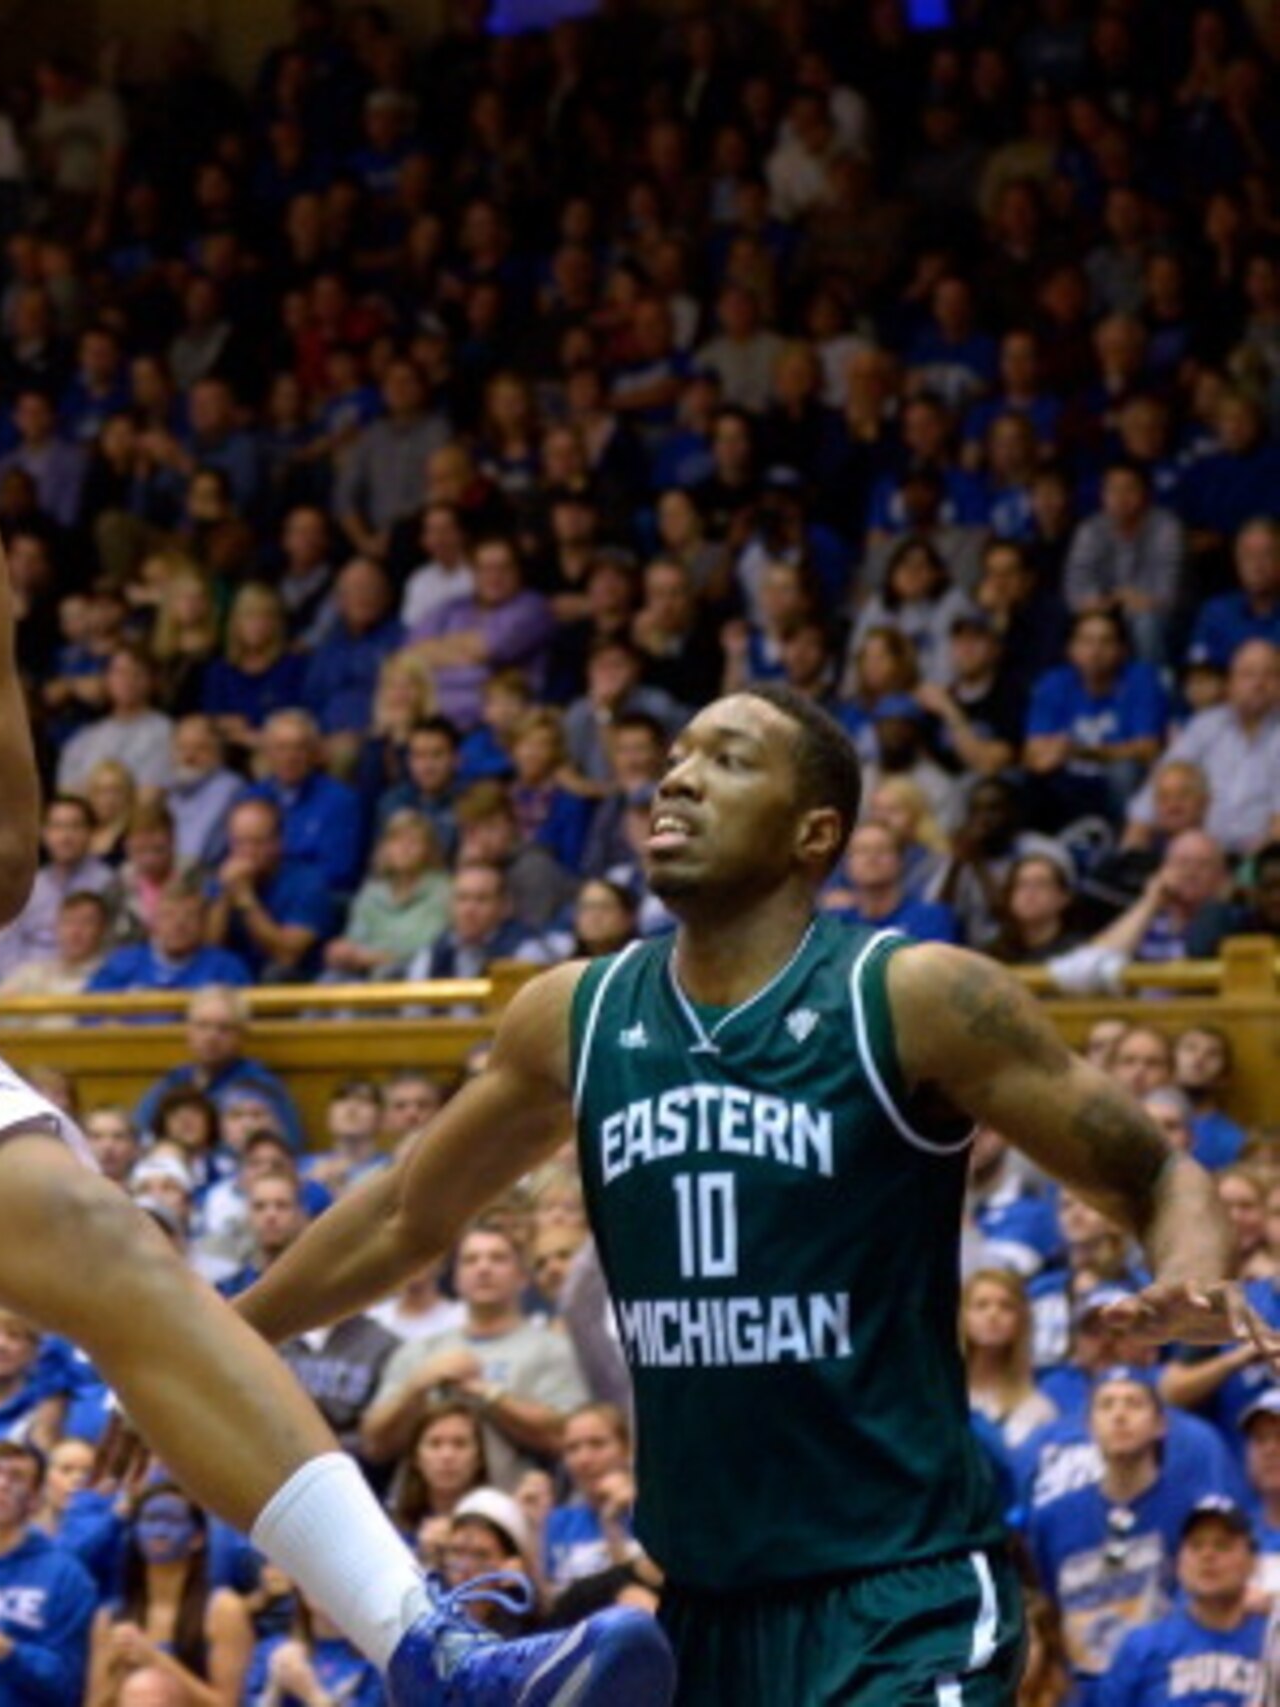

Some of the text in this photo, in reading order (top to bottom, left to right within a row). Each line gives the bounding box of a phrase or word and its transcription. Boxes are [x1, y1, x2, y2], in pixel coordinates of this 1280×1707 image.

[601, 1081, 833, 1187] EASTERN
[673, 1171, 738, 1278] 10
[620, 1292, 853, 1368] MICHIGAN
